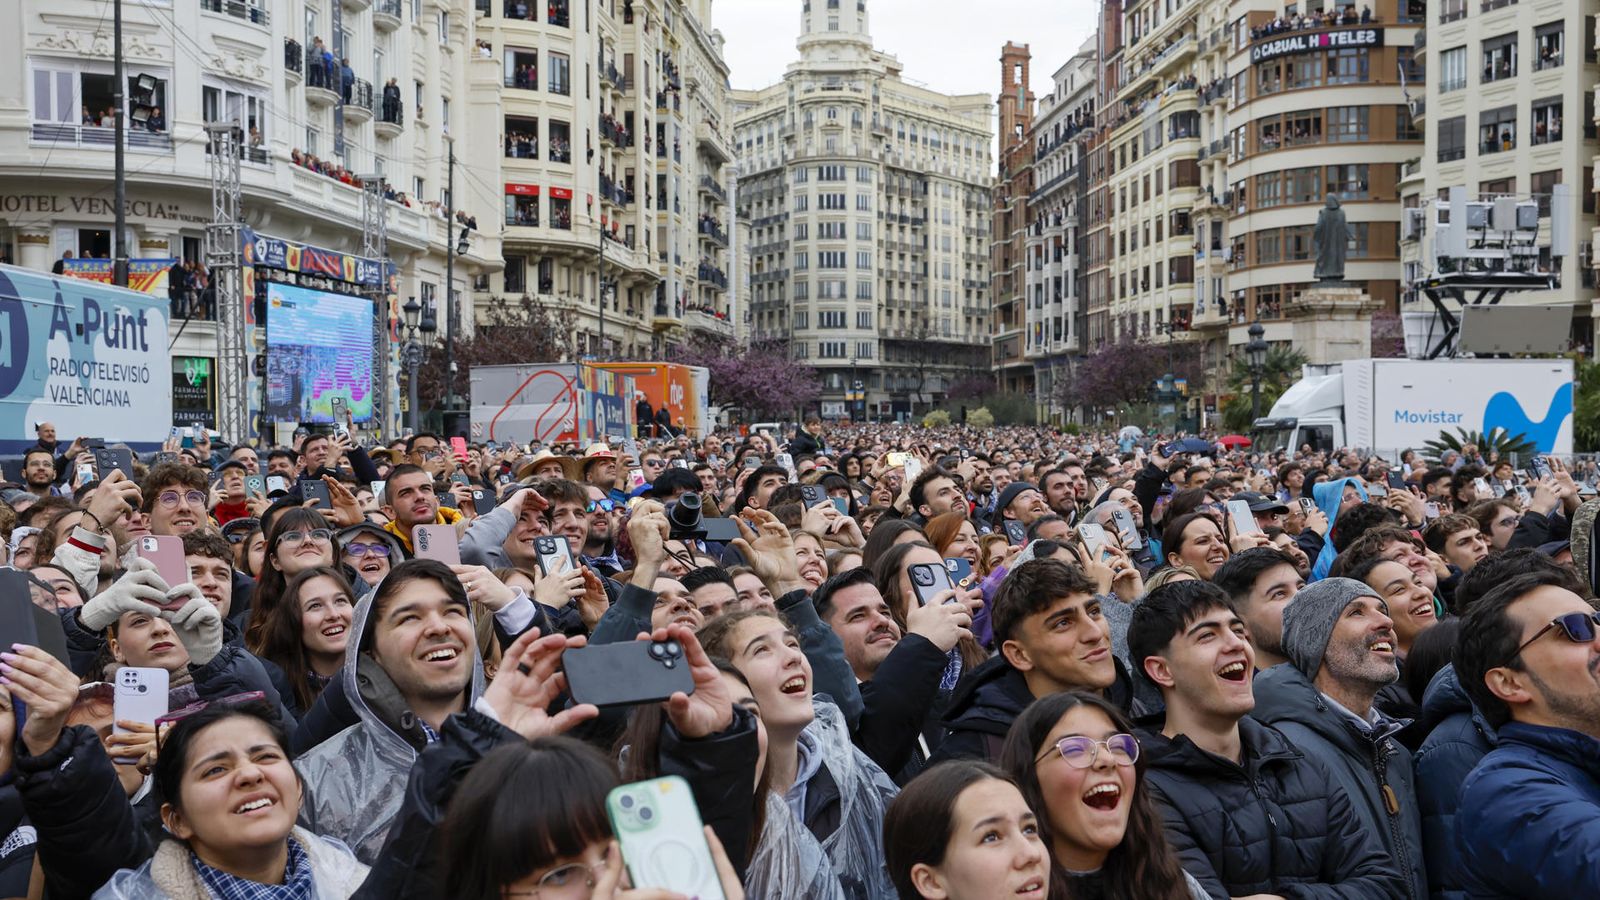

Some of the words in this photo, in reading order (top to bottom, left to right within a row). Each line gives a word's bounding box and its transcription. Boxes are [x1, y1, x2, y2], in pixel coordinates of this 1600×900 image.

[1261, 37, 1306, 57] CASUAL
[83, 297, 149, 352] Punt
[50, 357, 150, 384] RADIOTELEVISIÓ
[50, 384, 131, 407] VALENCIANA
[174, 412, 214, 421] FARMACIA
[1394, 409, 1463, 423] Movistar
